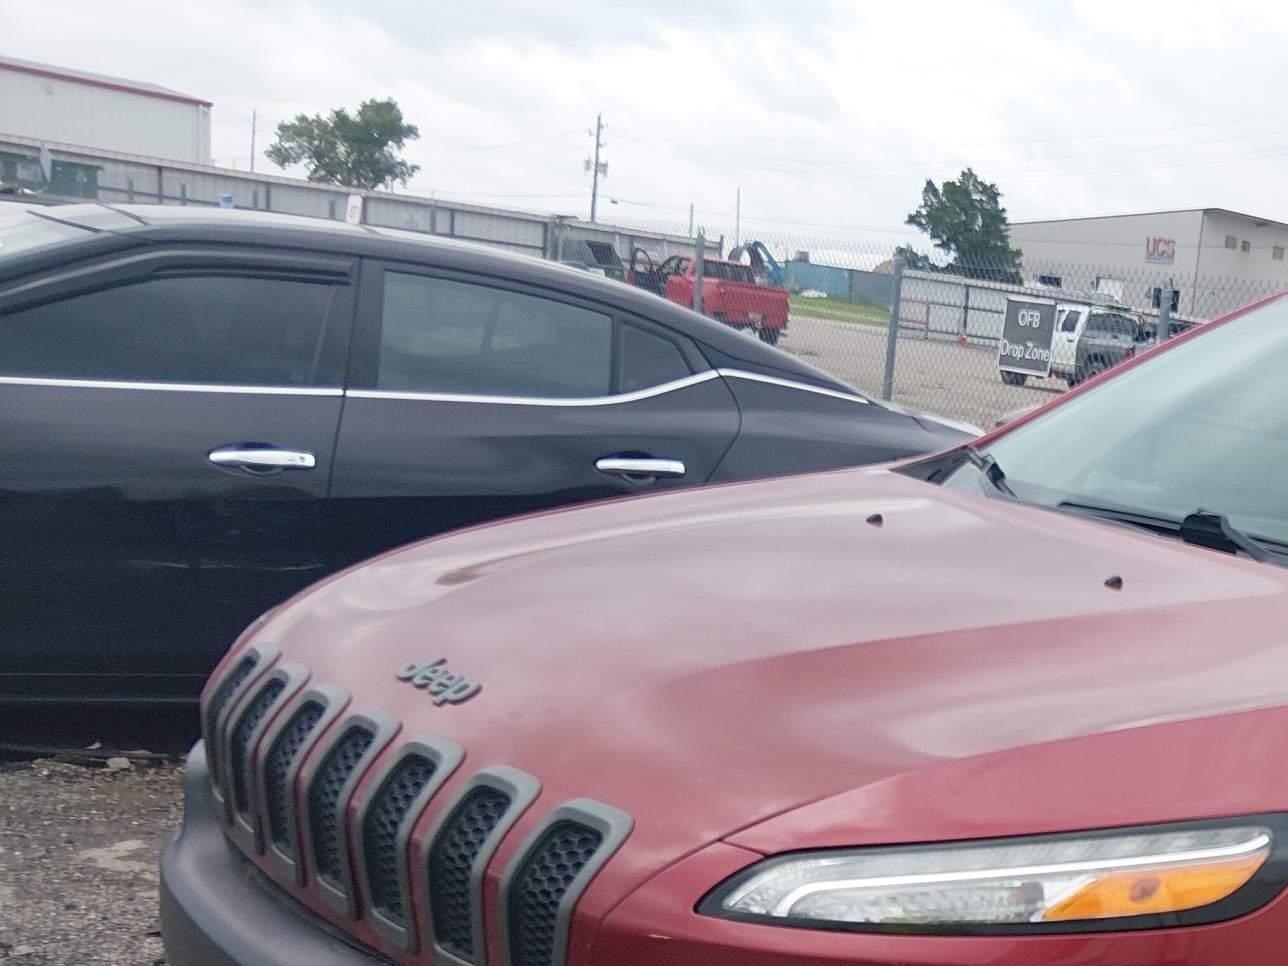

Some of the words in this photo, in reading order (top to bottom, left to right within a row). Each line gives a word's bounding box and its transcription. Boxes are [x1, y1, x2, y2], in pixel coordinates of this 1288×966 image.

[1000, 340, 1024, 361] Drop
[1024, 342, 1050, 362] Zone
[396, 658, 483, 706] Jeep
